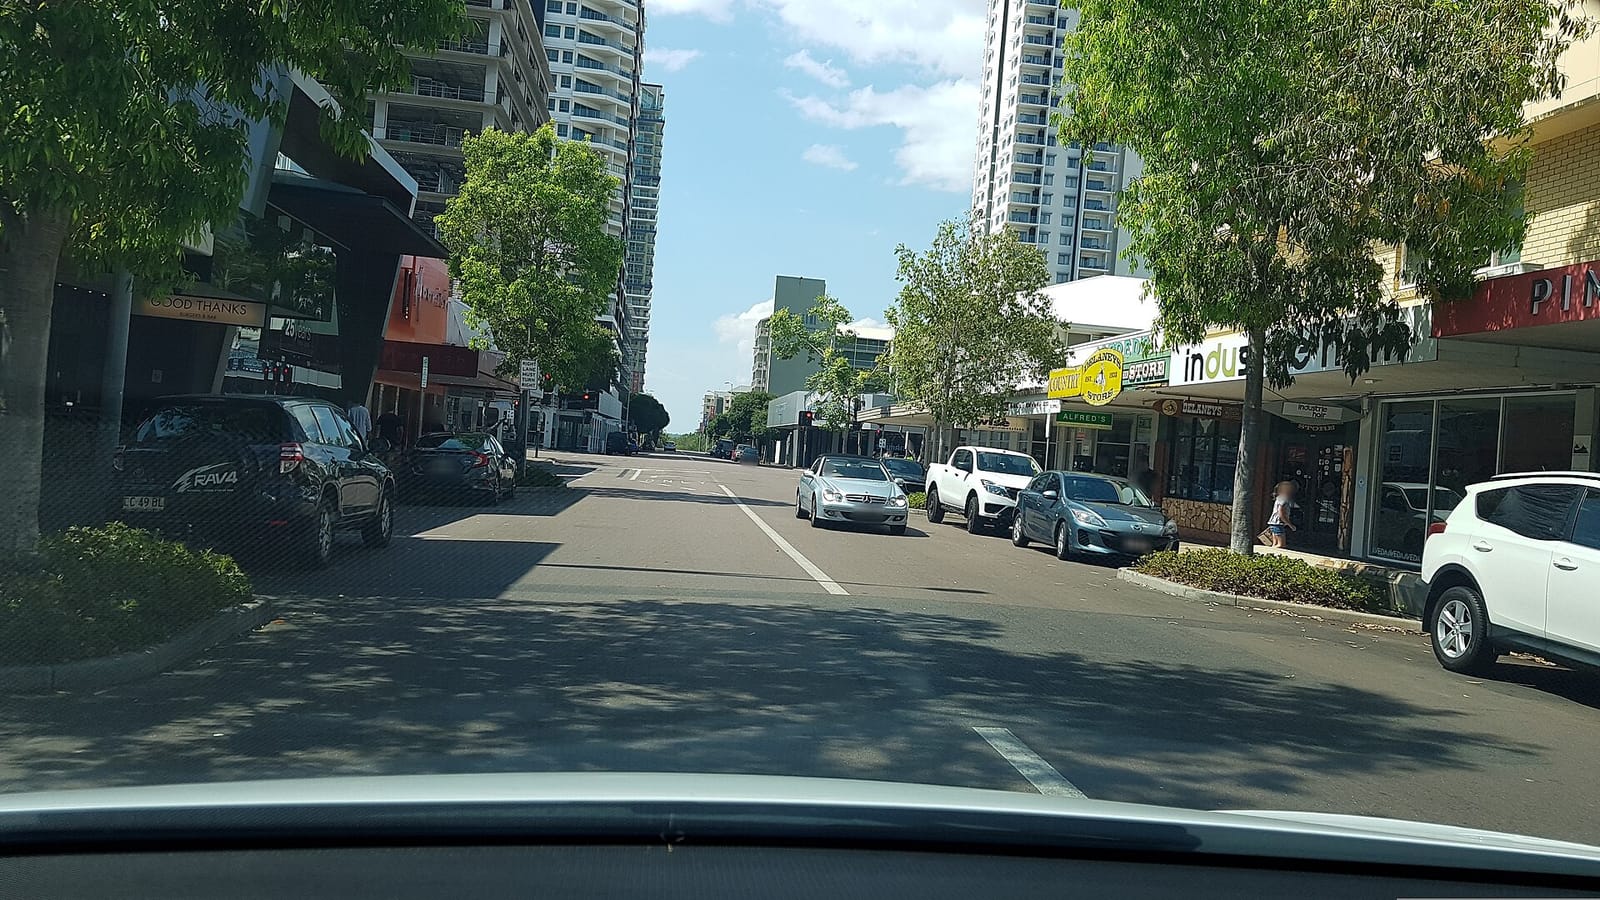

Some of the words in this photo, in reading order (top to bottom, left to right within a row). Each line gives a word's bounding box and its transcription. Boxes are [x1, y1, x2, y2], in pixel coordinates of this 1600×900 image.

[151, 297, 192, 310] GOOD
[197, 300, 247, 315] THANKS
[285, 318, 295, 337] 25
[1128, 361, 1166, 382] STORE
[1050, 373, 1080, 392] COUNTRY
[1087, 389, 1114, 401] STORE
[1062, 411, 1107, 423] ALFRED'S
[1182, 402, 1223, 416] DELANEYS
[194, 470, 239, 487] RAV4
